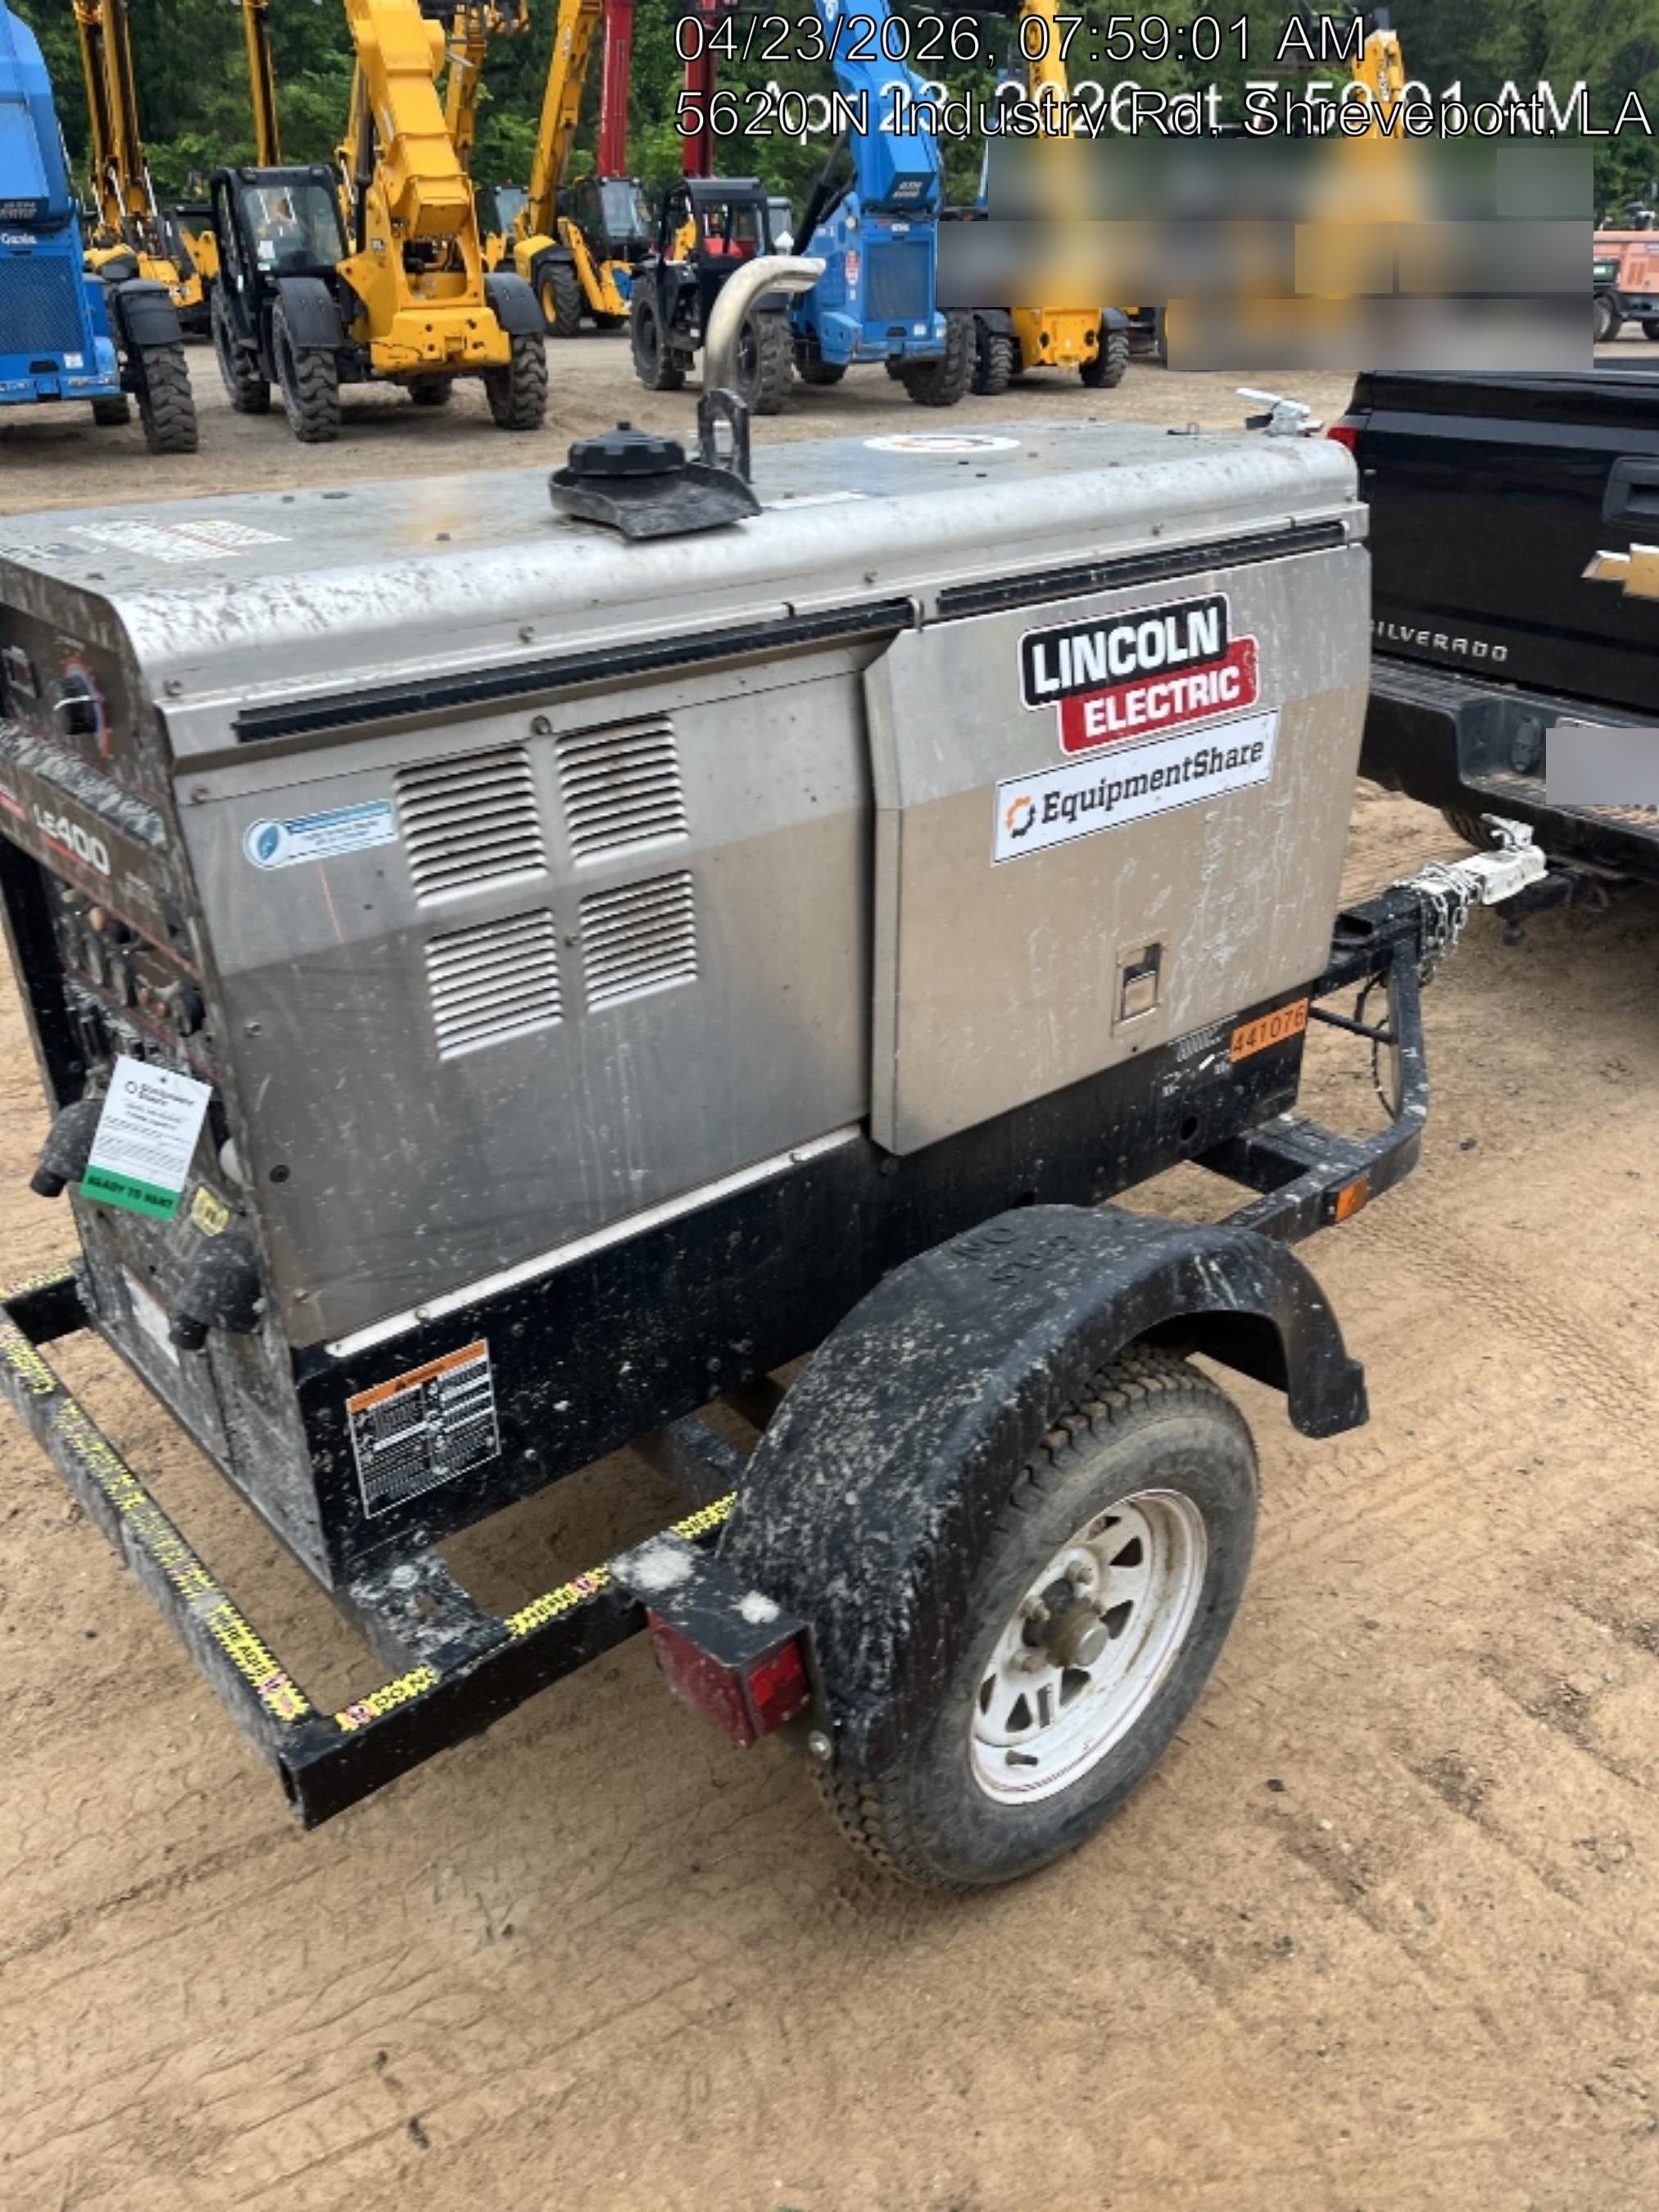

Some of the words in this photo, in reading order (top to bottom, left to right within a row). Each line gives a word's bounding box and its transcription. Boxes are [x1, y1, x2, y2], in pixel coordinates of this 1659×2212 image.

[1032, 606, 1221, 694] LINCOLN
[1083, 666, 1240, 737] ELECTRIC
[1041, 740, 1265, 824] EquipmentShare
[1233, 1004, 1305, 1054] 441076
